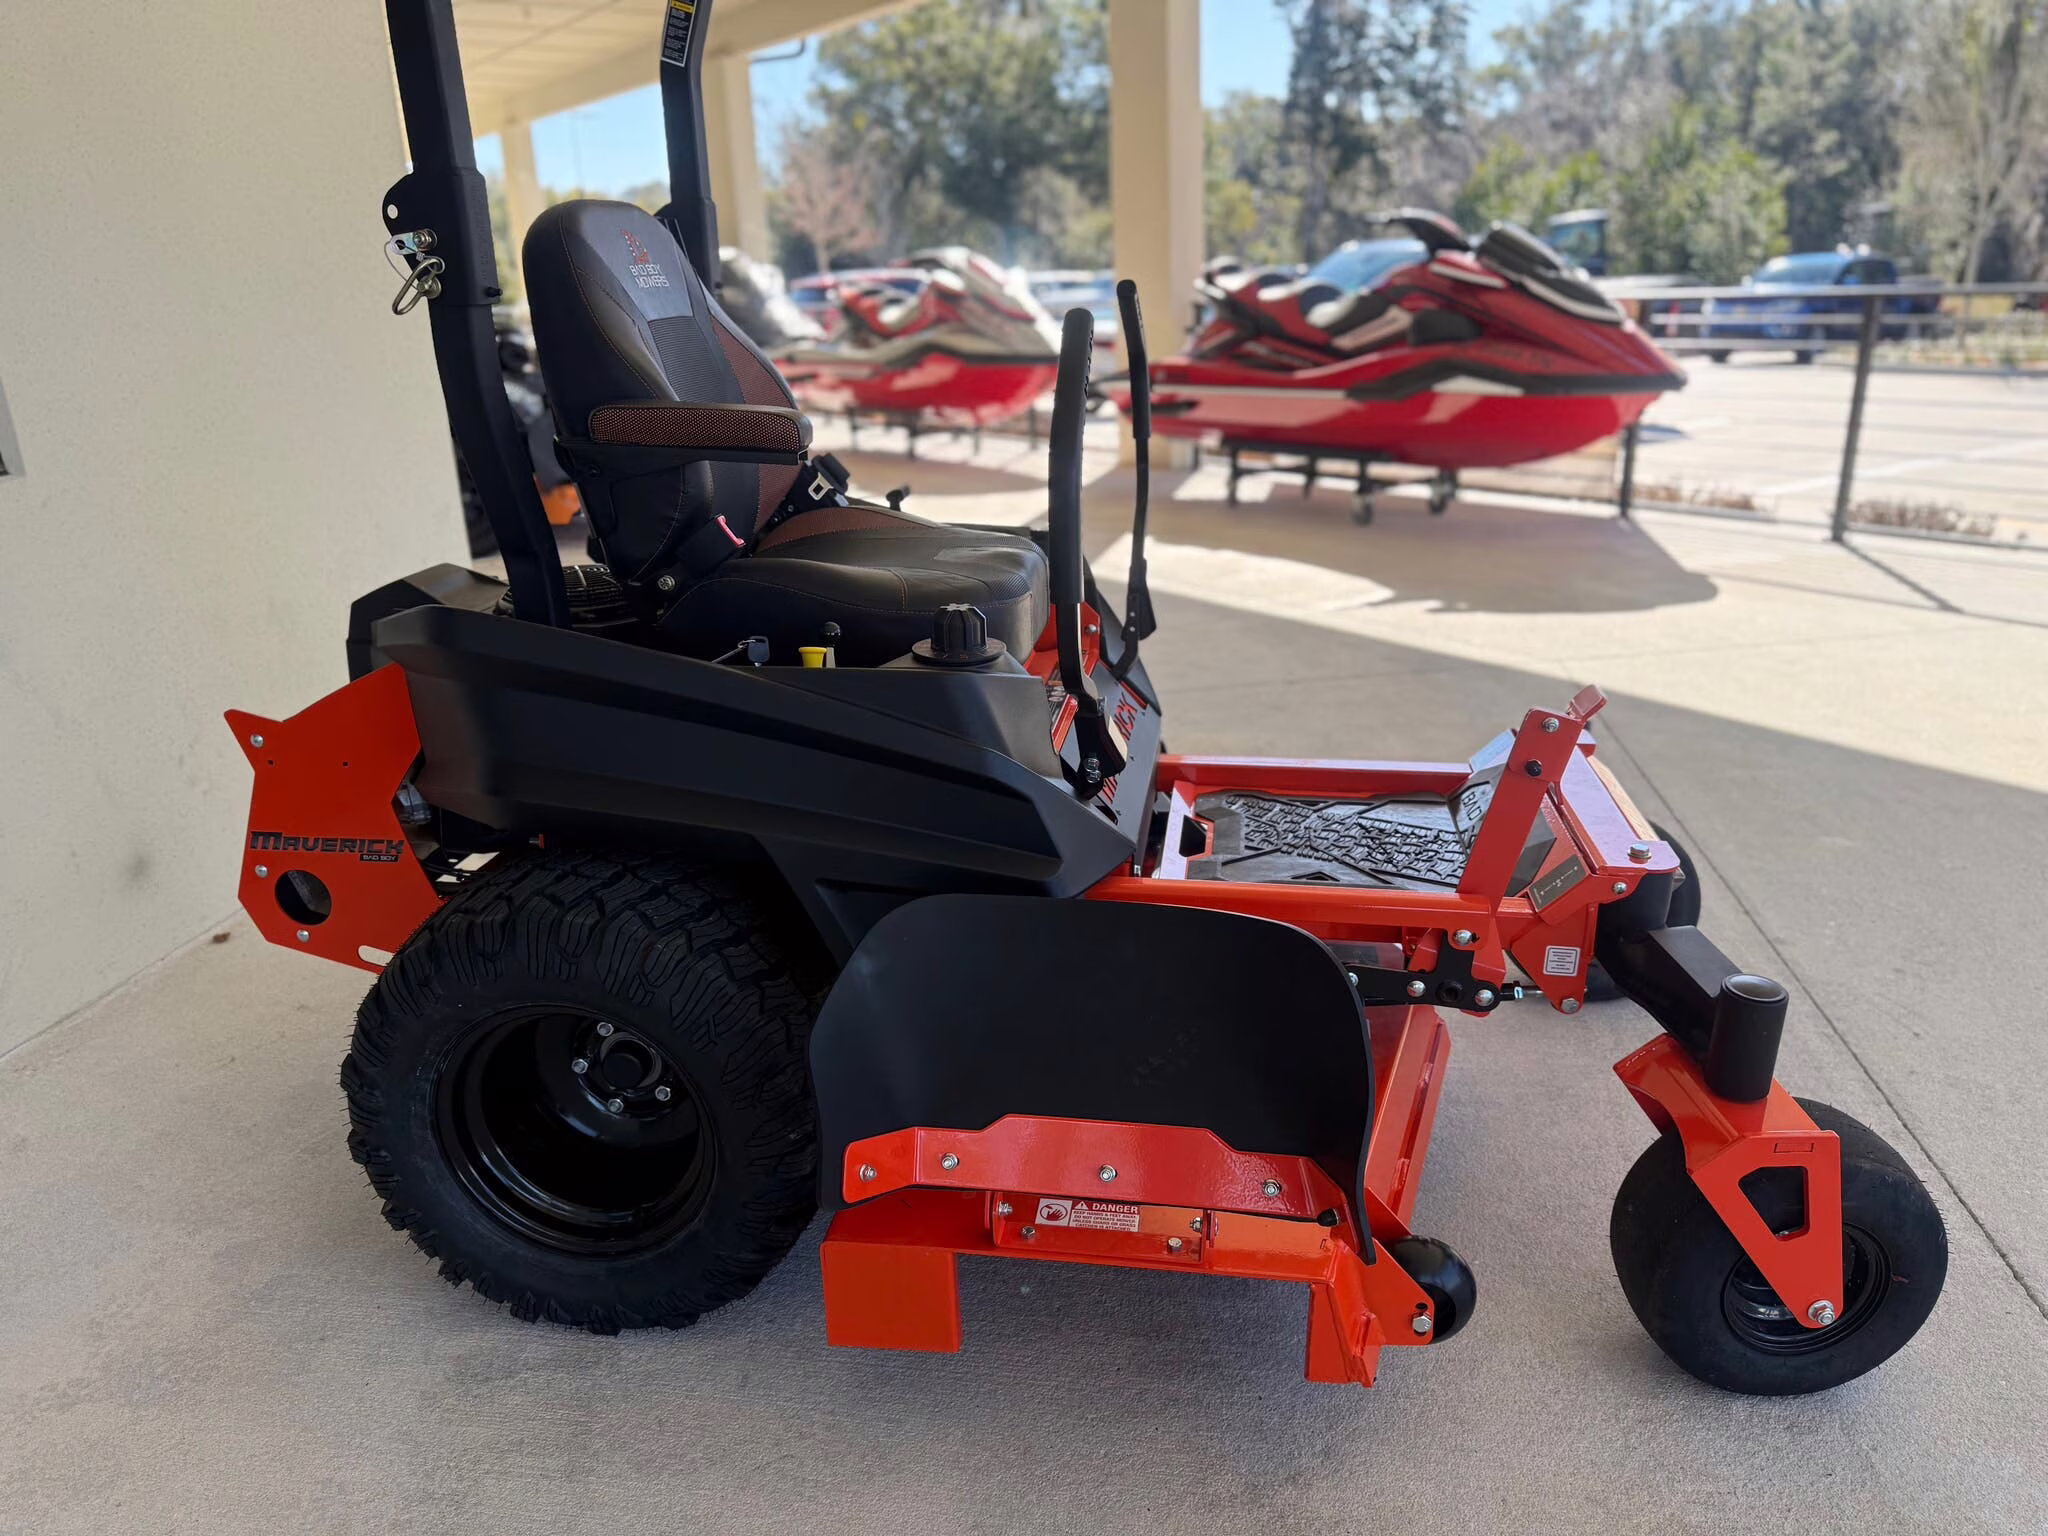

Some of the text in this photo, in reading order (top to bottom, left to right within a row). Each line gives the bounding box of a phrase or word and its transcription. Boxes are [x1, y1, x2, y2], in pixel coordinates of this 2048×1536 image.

[630, 264, 662, 276] BAD BOY
[635, 275, 670, 288] MOWERS
[1461, 791, 1482, 820] BAD
[250, 831, 405, 854] MAVERICK
[1092, 1203, 1138, 1213] DANGER
